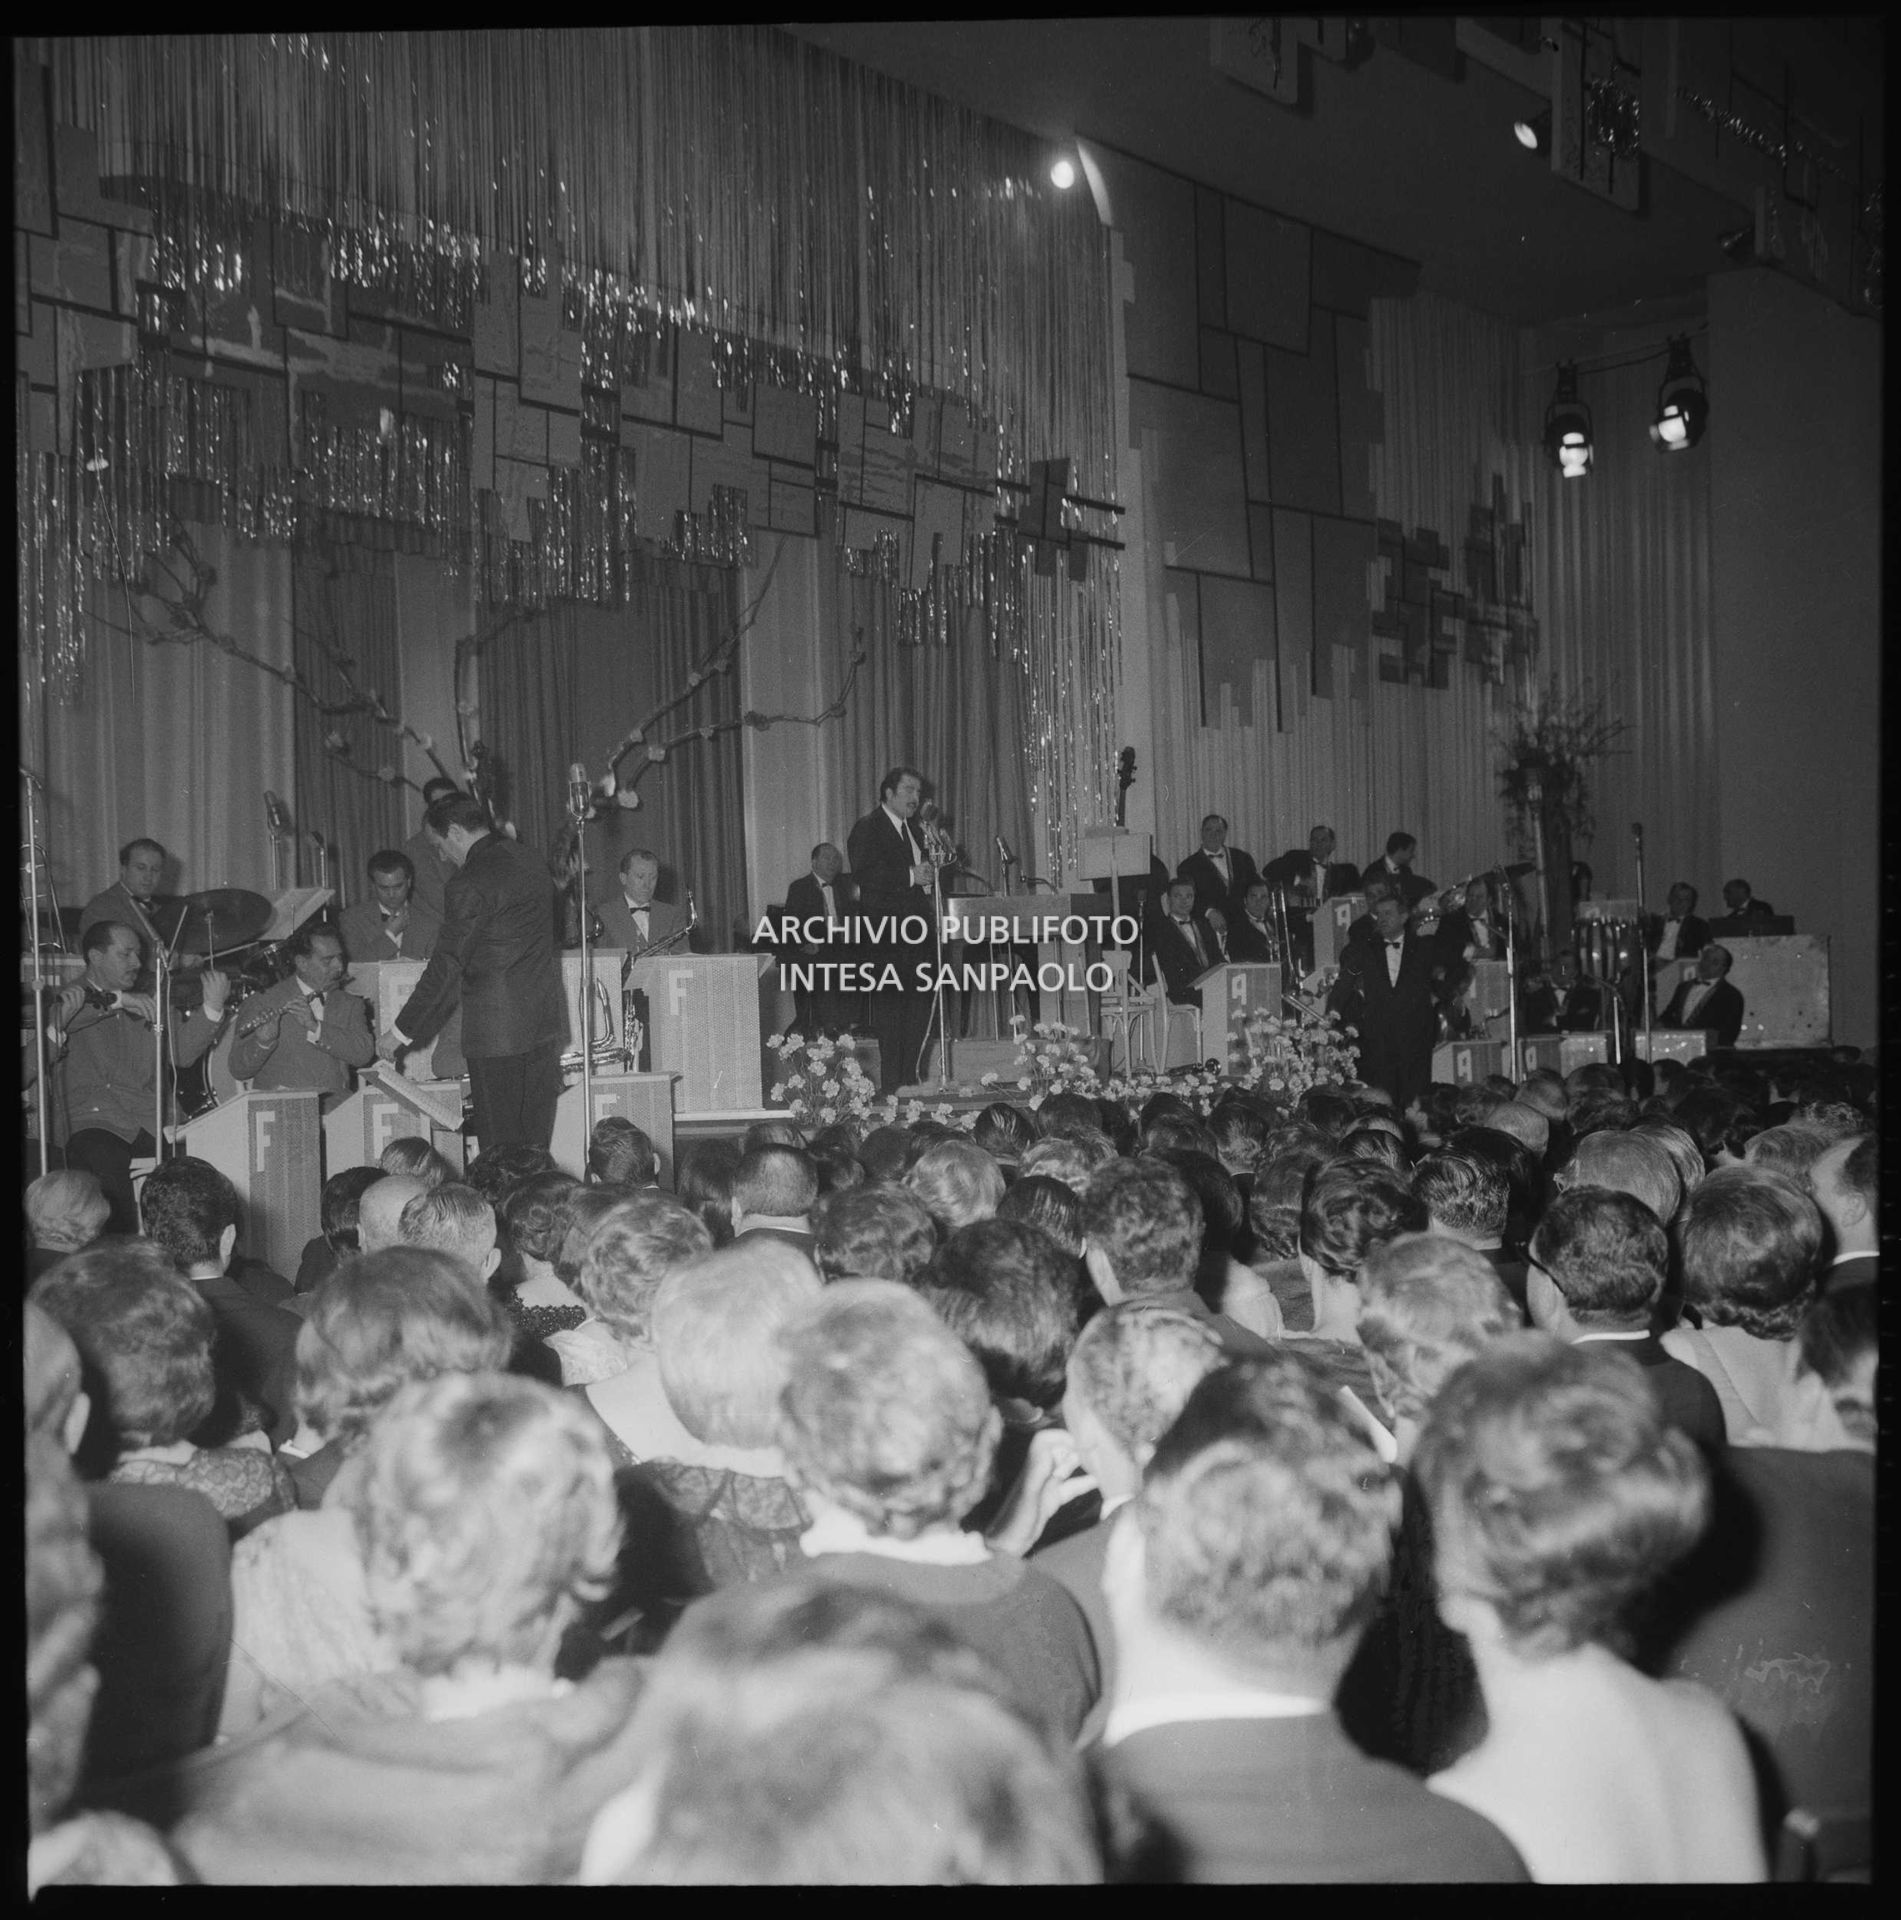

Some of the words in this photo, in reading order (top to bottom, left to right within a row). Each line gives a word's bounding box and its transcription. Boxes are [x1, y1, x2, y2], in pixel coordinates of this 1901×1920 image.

[669, 969, 693, 1016] F
[256, 1110, 276, 1172] F
[372, 1103, 398, 1159] F
